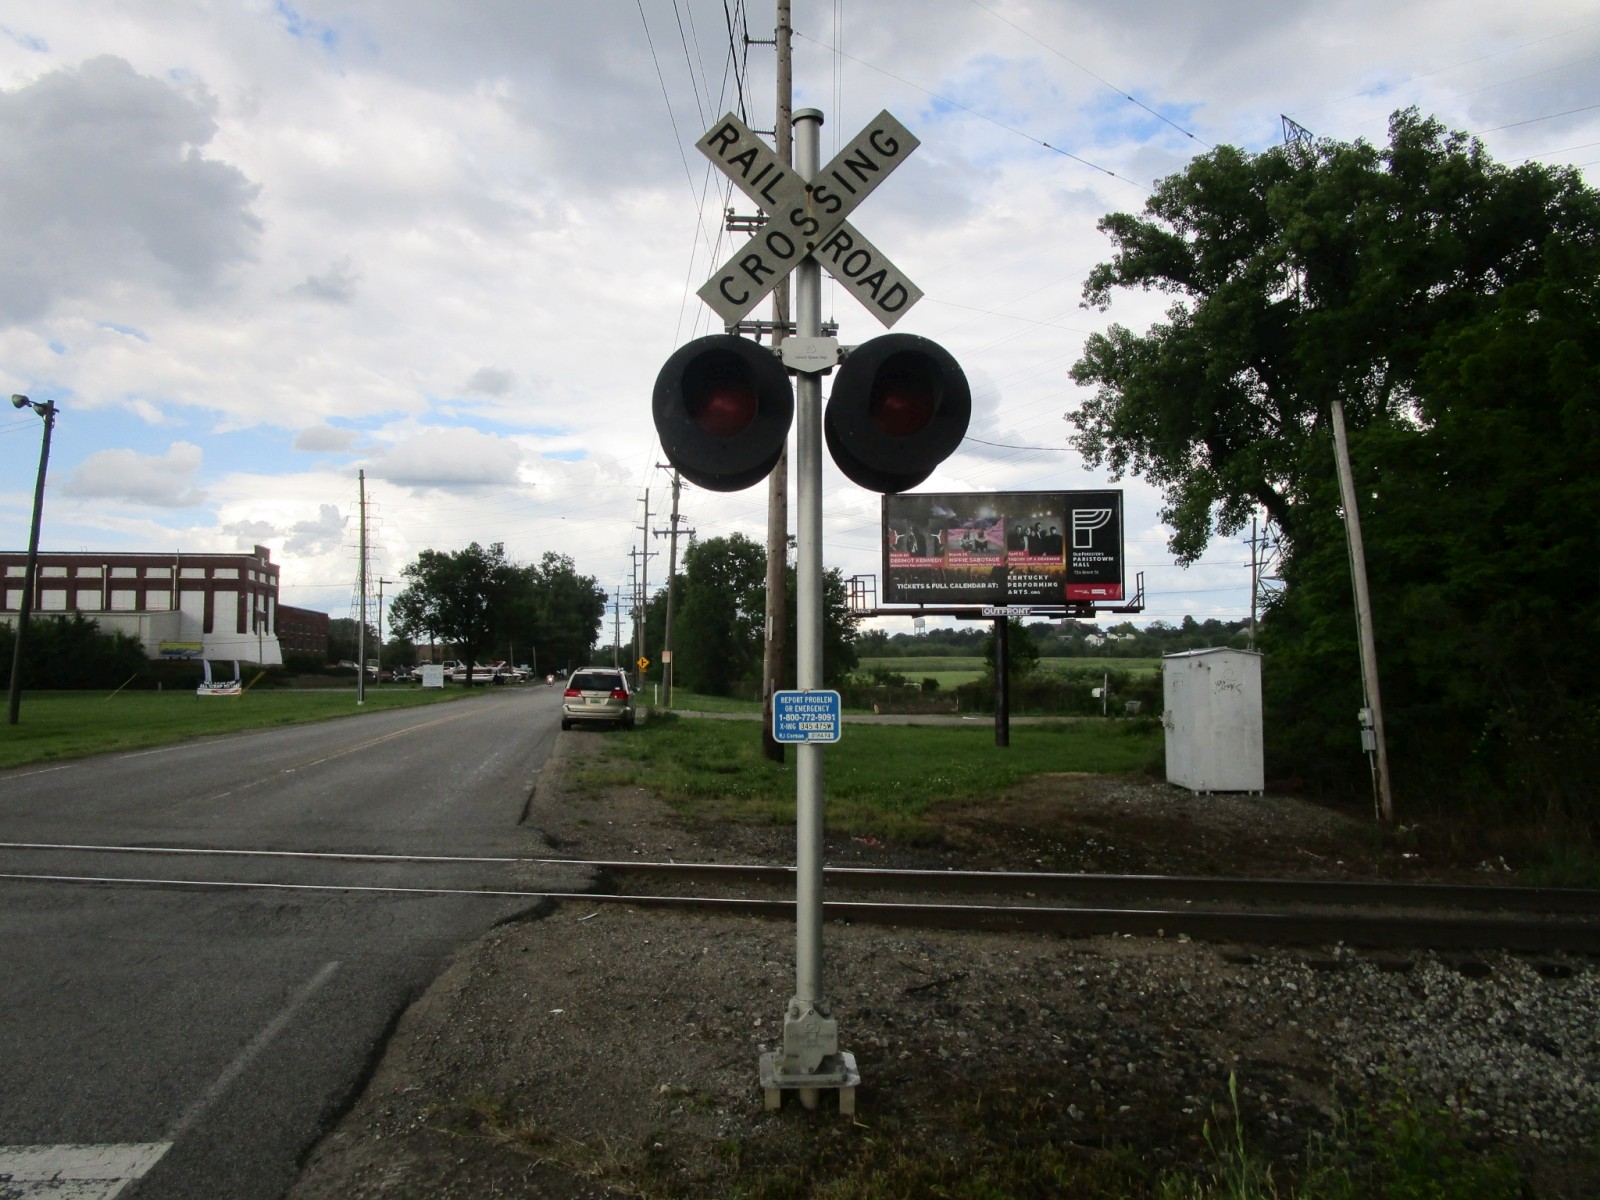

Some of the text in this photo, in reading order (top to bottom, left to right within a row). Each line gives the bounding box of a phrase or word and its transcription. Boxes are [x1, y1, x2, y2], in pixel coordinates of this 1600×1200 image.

[707, 122, 909, 313] RAIL ROAD
[719, 129, 900, 306] CROSSING
[984, 607, 1030, 615] OUTFRONT
[780, 696, 833, 704] REPORT PROBLEM
[784, 704, 830, 712] OR EMERGENCY
[779, 713, 836, 721] 1-800-772-9091
[779, 722, 797, 730] X-ING
